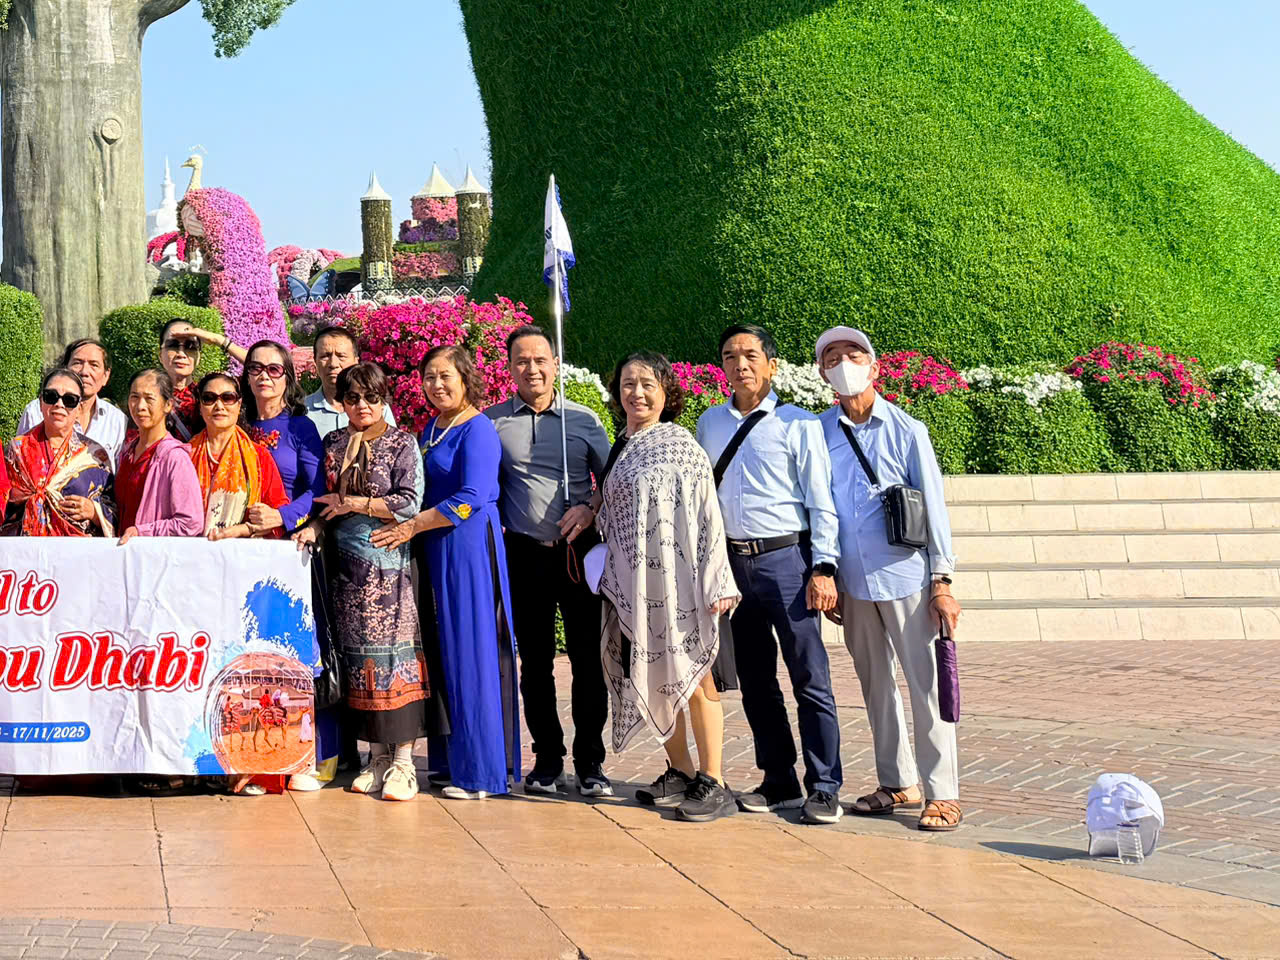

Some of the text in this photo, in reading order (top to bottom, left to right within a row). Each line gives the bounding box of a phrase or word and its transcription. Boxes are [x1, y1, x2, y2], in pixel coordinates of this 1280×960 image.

[17, 571, 58, 615] to
[51, 632, 209, 690] Dhabi
[13, 726, 85, 741] 17/11/2025
